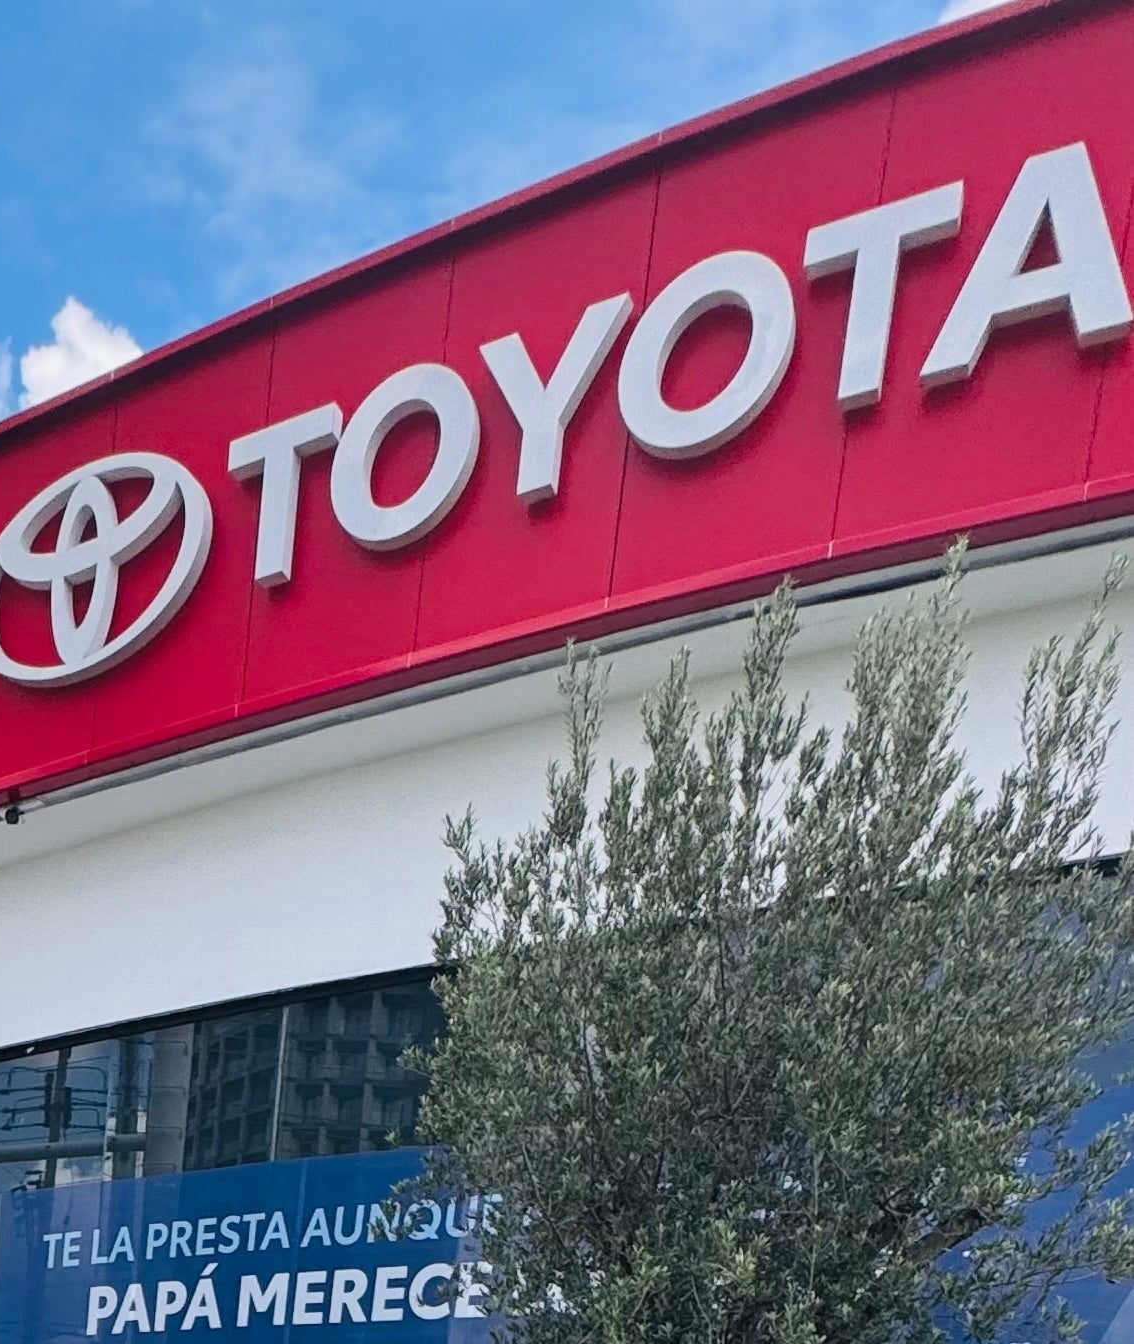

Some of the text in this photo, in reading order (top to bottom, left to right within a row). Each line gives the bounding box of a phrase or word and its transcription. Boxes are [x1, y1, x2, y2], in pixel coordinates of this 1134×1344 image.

[228, 140, 1133, 589] TOYOTA
[43, 1230, 82, 1270] TE
[90, 1221, 135, 1265] LA
[145, 1211, 291, 1261] PRESTA
[85, 1262, 223, 1337] PAPÁ
